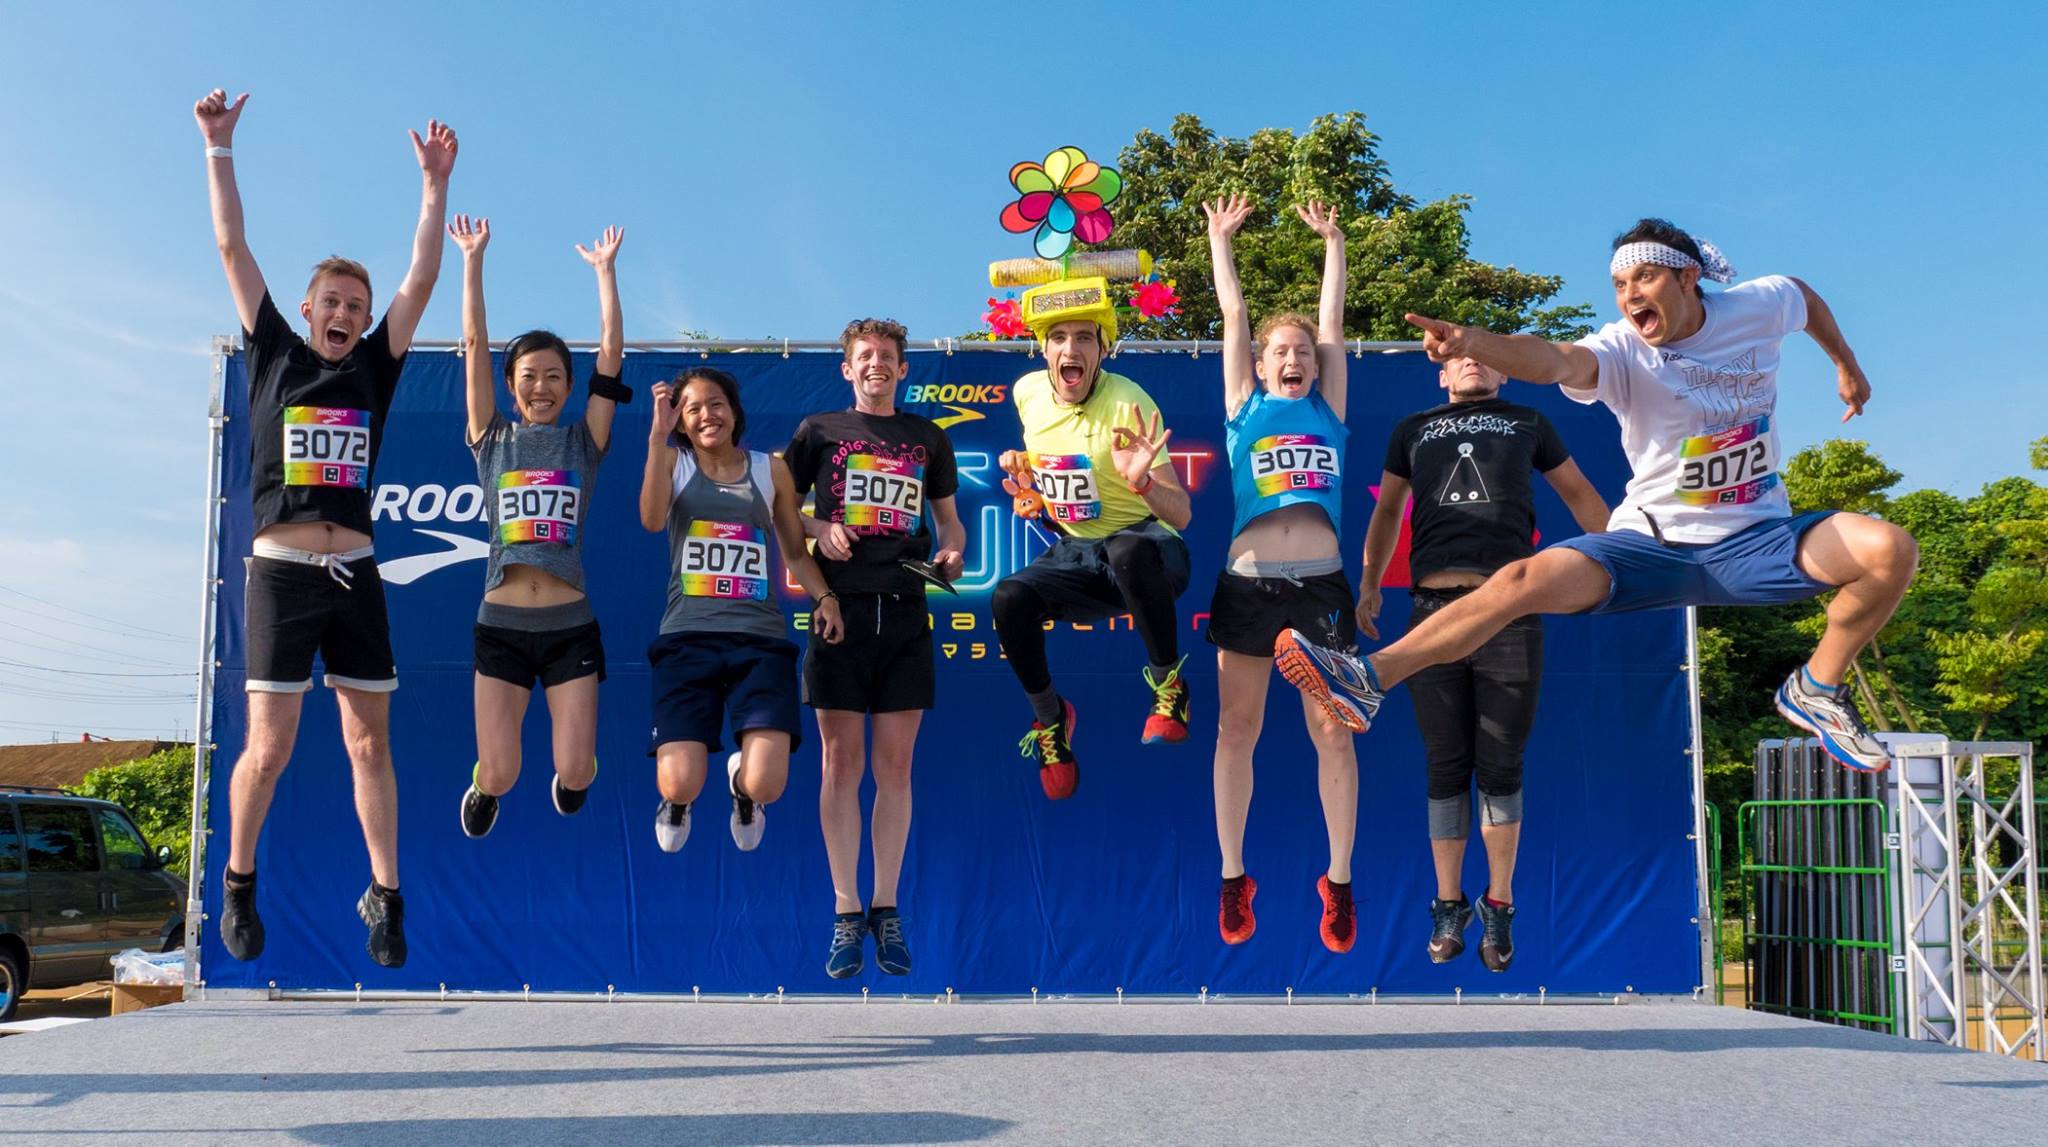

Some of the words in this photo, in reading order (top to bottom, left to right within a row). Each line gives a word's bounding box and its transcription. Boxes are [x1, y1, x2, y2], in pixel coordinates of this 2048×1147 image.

[903, 384, 1008, 403] BROOKS
[316, 408, 348, 417] BROOKS
[290, 429, 368, 463] 3072
[832, 440, 864, 466] 2016
[1256, 448, 1335, 474] 3072
[1682, 440, 1768, 490] 3072
[370, 483, 489, 522] ROO
[502, 489, 576, 521] 3072
[850, 474, 919, 512] 3072
[713, 522, 743, 532] BROOKS
[686, 541, 761, 576] 3072
